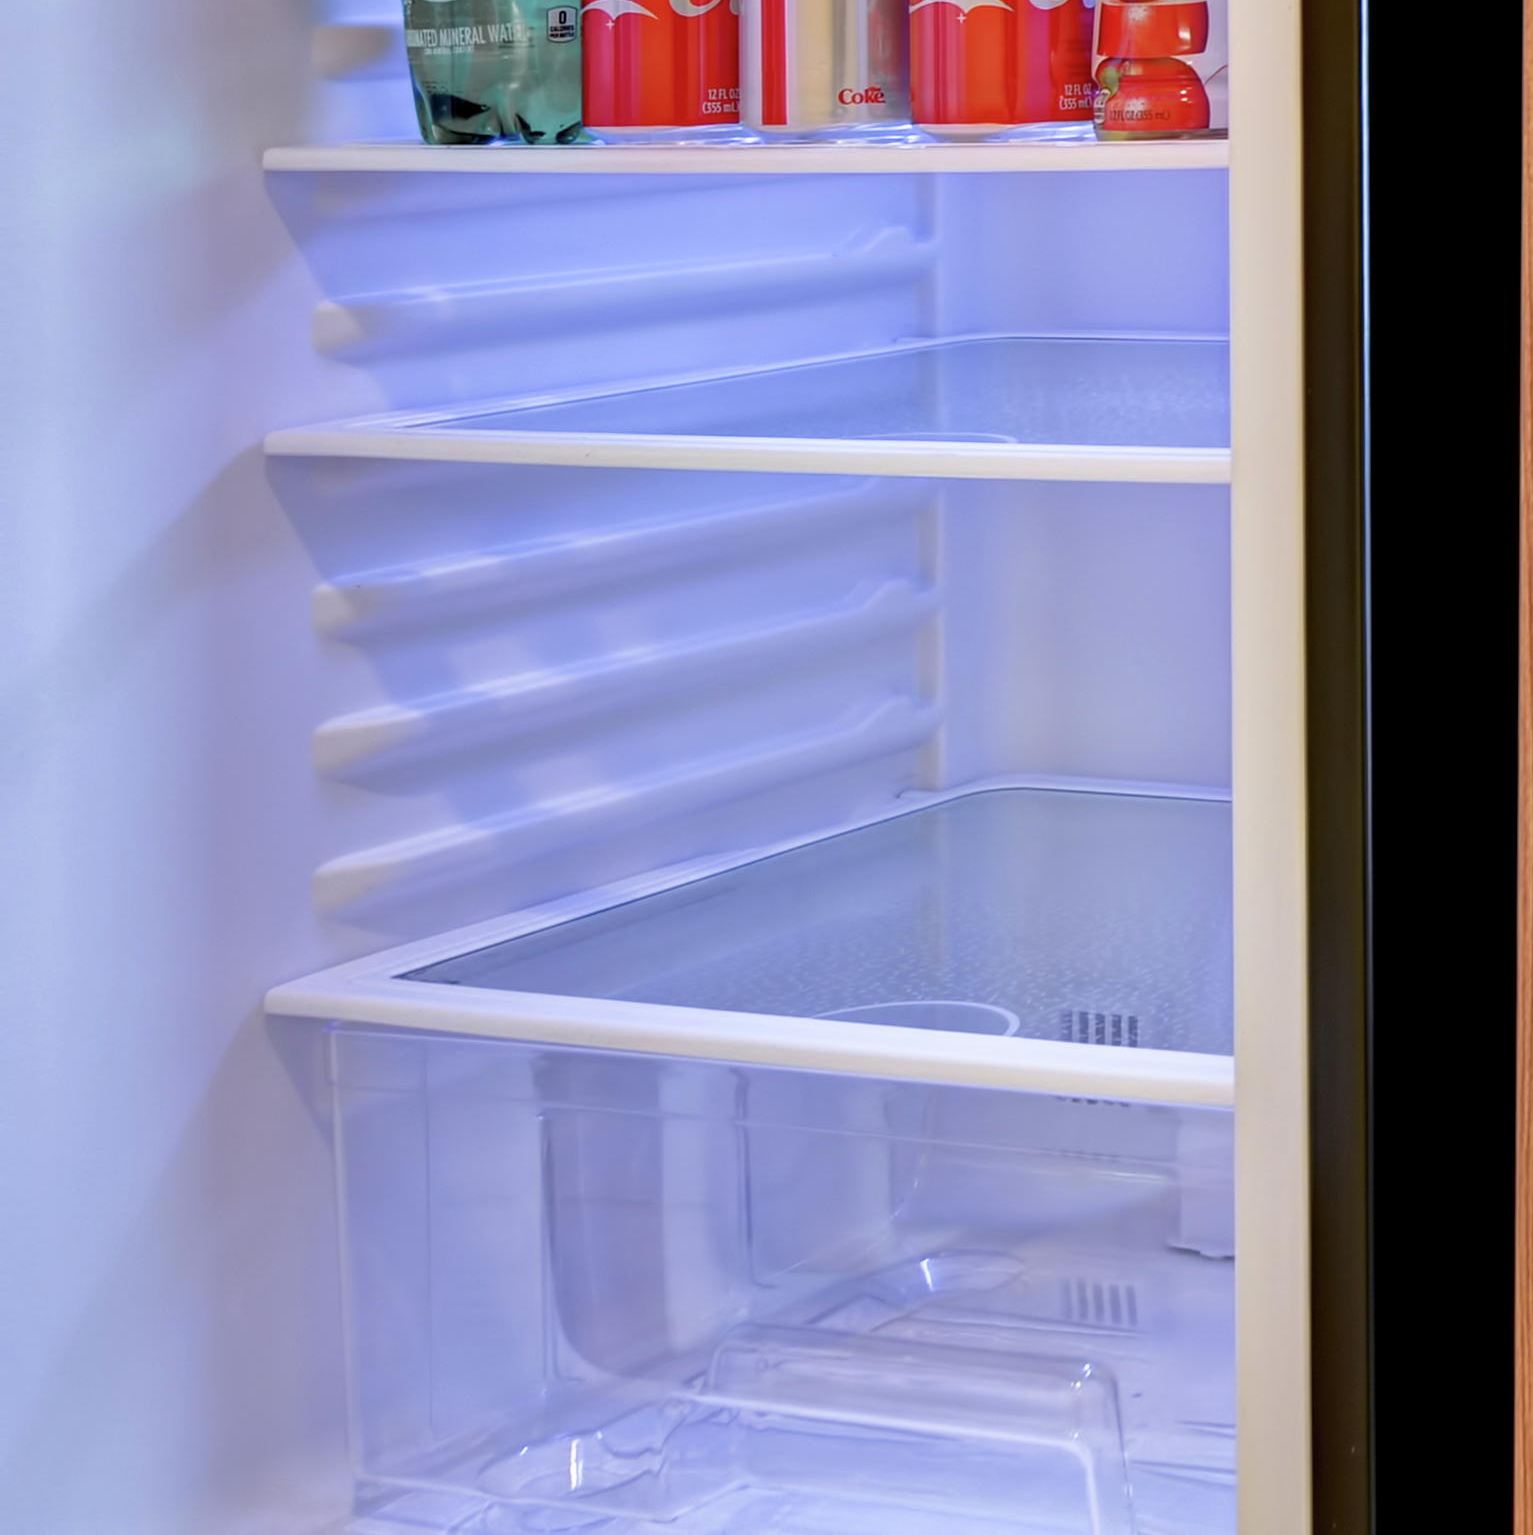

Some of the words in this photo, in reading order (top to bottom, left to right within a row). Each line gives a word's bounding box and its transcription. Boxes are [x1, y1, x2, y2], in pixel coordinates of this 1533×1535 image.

[558, 10, 567, 24] 0
[439, 25, 485, 46] MINERAL
[708, 88, 718, 100] 12
[719, 88, 728, 100] FL
[838, 86, 886, 105] Coke
[1064, 84, 1073, 96] 12
[1074, 84, 1082, 96] FL
[1083, 83, 1092, 95] OZ
